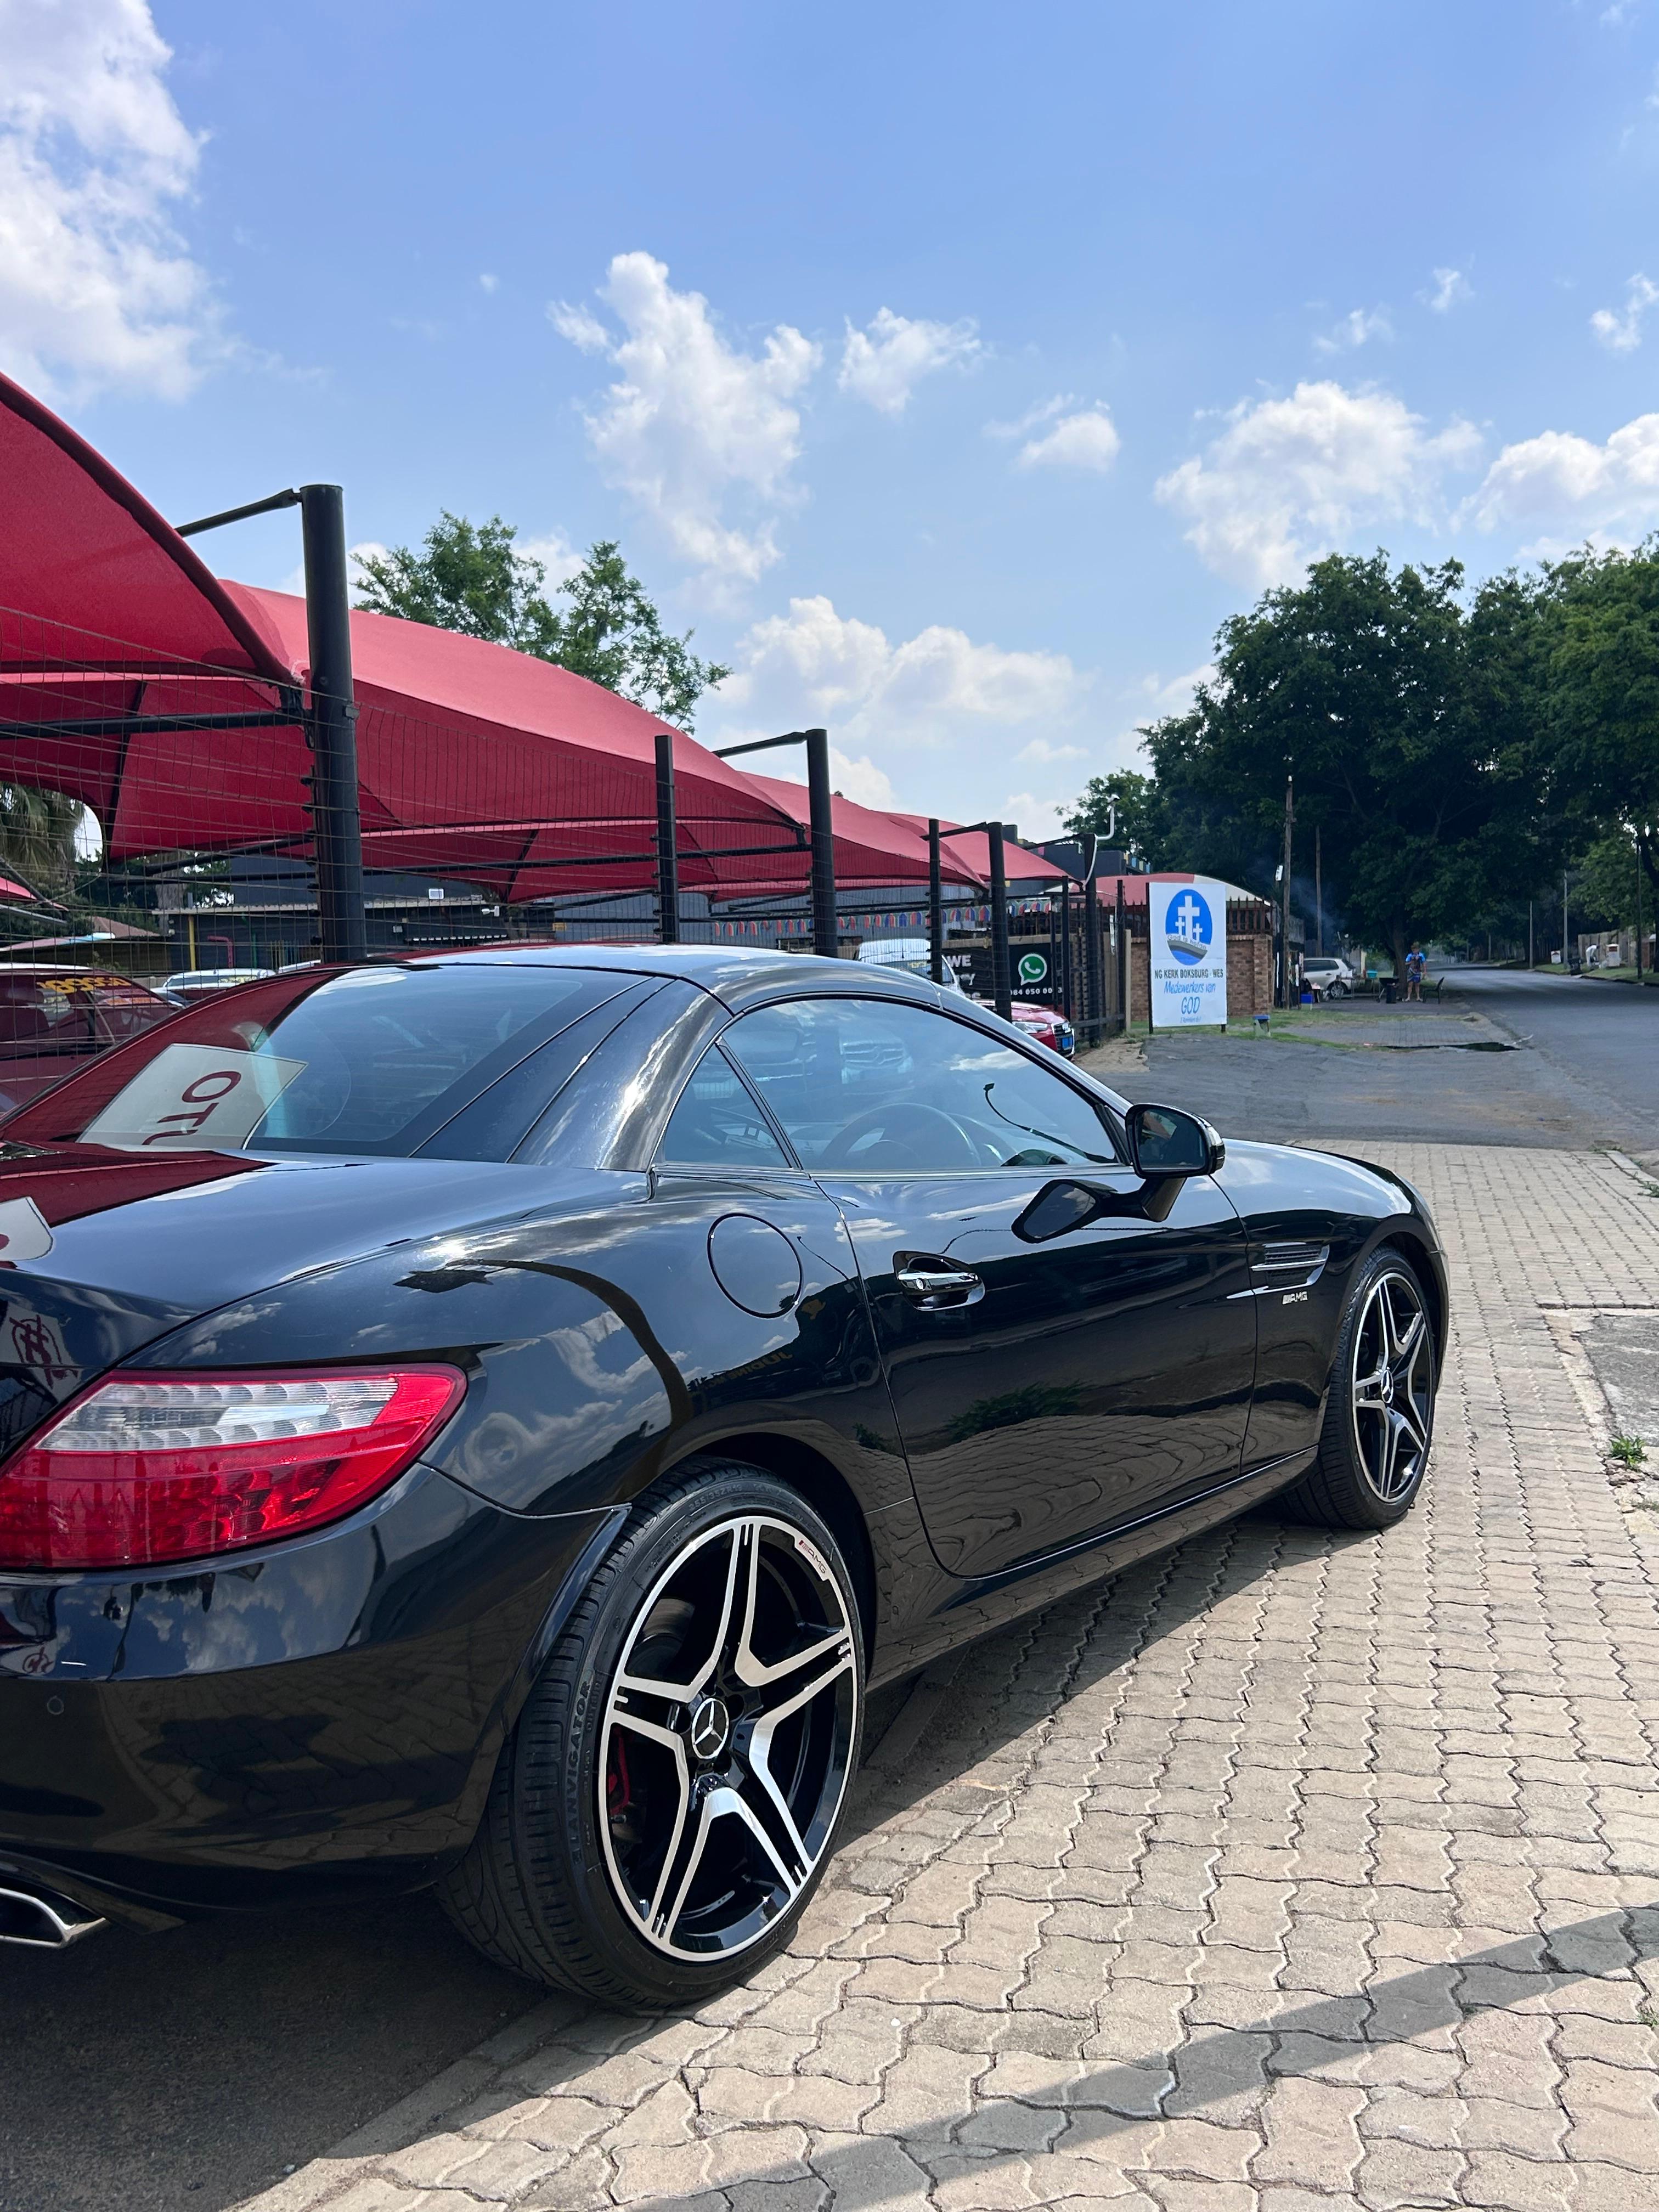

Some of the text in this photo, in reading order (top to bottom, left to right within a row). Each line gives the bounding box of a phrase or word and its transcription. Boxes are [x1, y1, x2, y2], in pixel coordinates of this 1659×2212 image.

[947, 955, 972, 967] WE
[1154, 968, 1223, 979] NG KERK BOKSBURG WES
[1164, 981, 1216, 994] Medewerkers van
[1181, 996, 1200, 1014] GOD
[1289, 1291, 1308, 1303] AMG
[806, 1547, 827, 1574] AMG
[567, 1680, 591, 1844] LANVIGATOR
